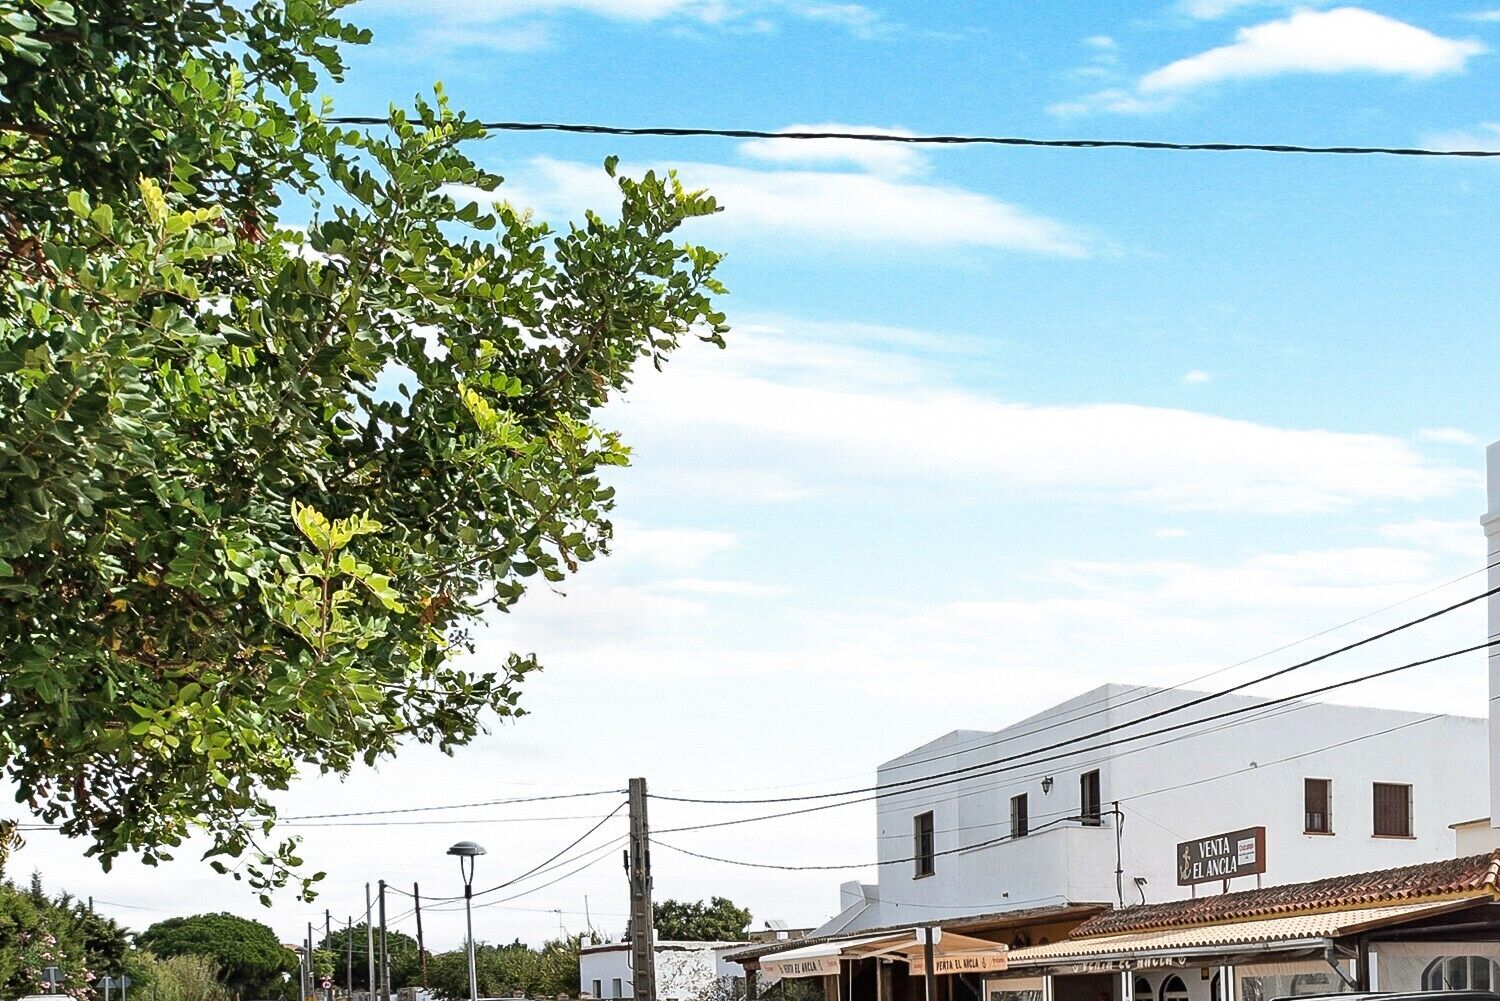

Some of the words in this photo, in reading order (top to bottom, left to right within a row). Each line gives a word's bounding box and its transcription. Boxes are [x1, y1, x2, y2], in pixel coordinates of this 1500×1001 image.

[1199, 837, 1231, 859] VENTA
[1193, 862, 1204, 880] EL
[1206, 855, 1238, 877] ANCLA
[795, 962, 801, 974] EL
[935, 958, 953, 971] VENTA
[955, 959, 962, 970] EL
[964, 957, 979, 969] ANCLA
